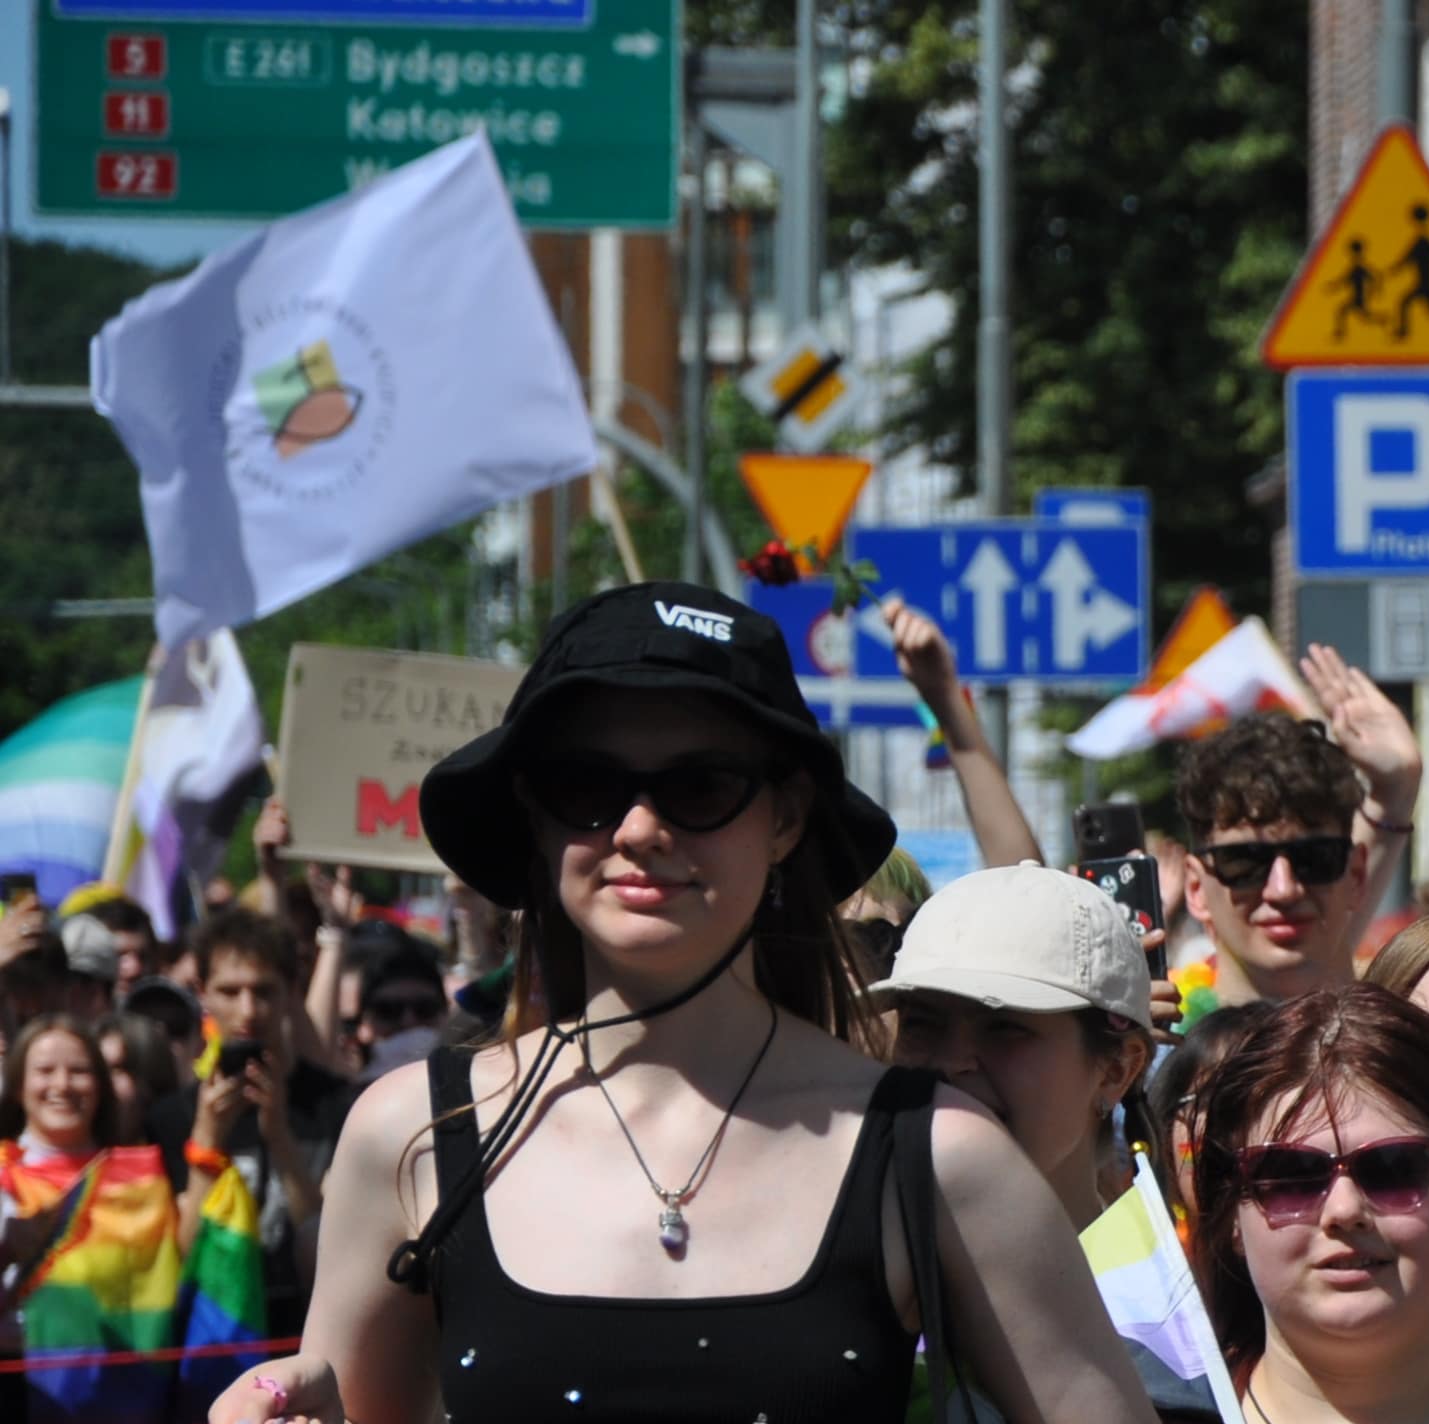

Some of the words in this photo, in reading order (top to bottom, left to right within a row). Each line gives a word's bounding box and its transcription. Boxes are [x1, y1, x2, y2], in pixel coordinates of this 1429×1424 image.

[123, 42, 148, 76] 5
[226, 44, 244, 77] E
[252, 44, 312, 78] 261
[346, 40, 587, 90] Bydgoszcz
[119, 97, 150, 130] 11
[345, 100, 561, 146] Katowice
[112, 158, 160, 195] 92
[655, 601, 734, 643] VANS
